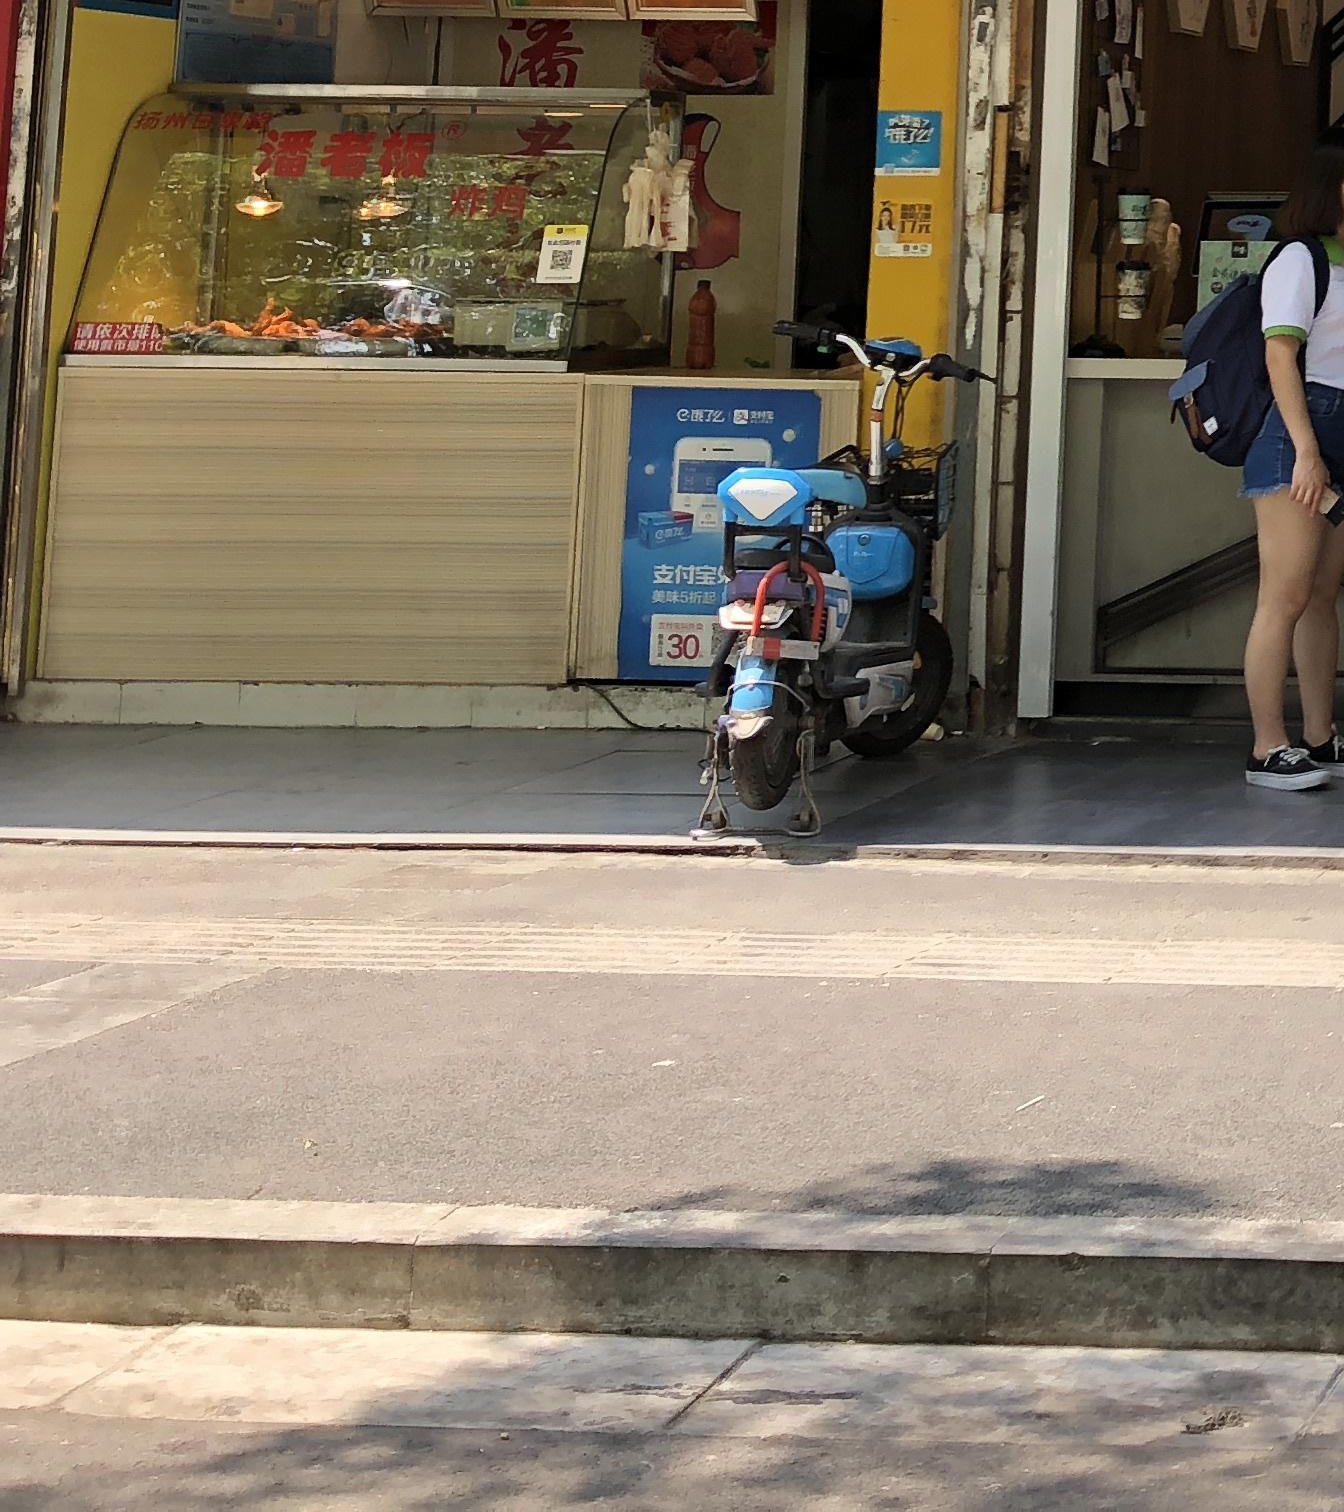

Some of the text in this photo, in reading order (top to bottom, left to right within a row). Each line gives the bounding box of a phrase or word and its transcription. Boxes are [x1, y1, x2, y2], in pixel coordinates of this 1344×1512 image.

[651, 589, 717, 605] 美味5折起
[666, 633, 700, 660] 30
